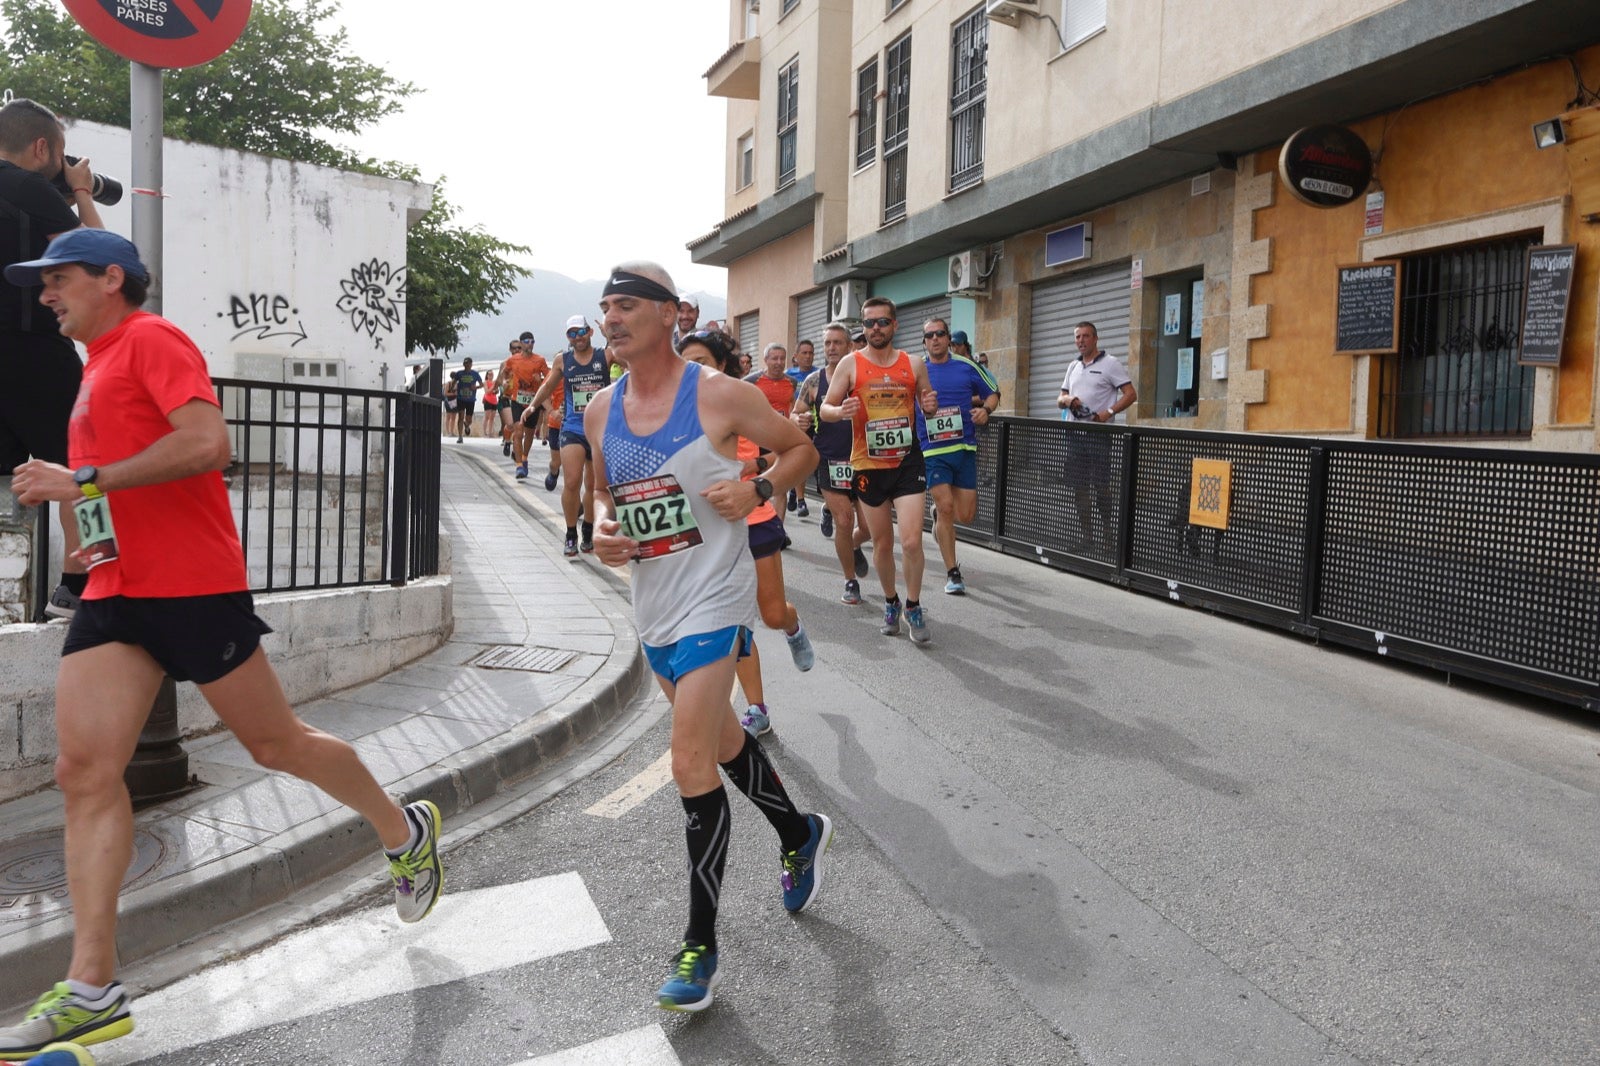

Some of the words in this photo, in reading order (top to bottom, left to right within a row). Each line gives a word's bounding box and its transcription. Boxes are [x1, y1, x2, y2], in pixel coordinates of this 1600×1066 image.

[116, 6, 165, 27] PARES
[936, 417, 954, 430] 84
[875, 430, 904, 446] 561
[836, 466, 852, 478] 80
[622, 498, 686, 537] 1027
